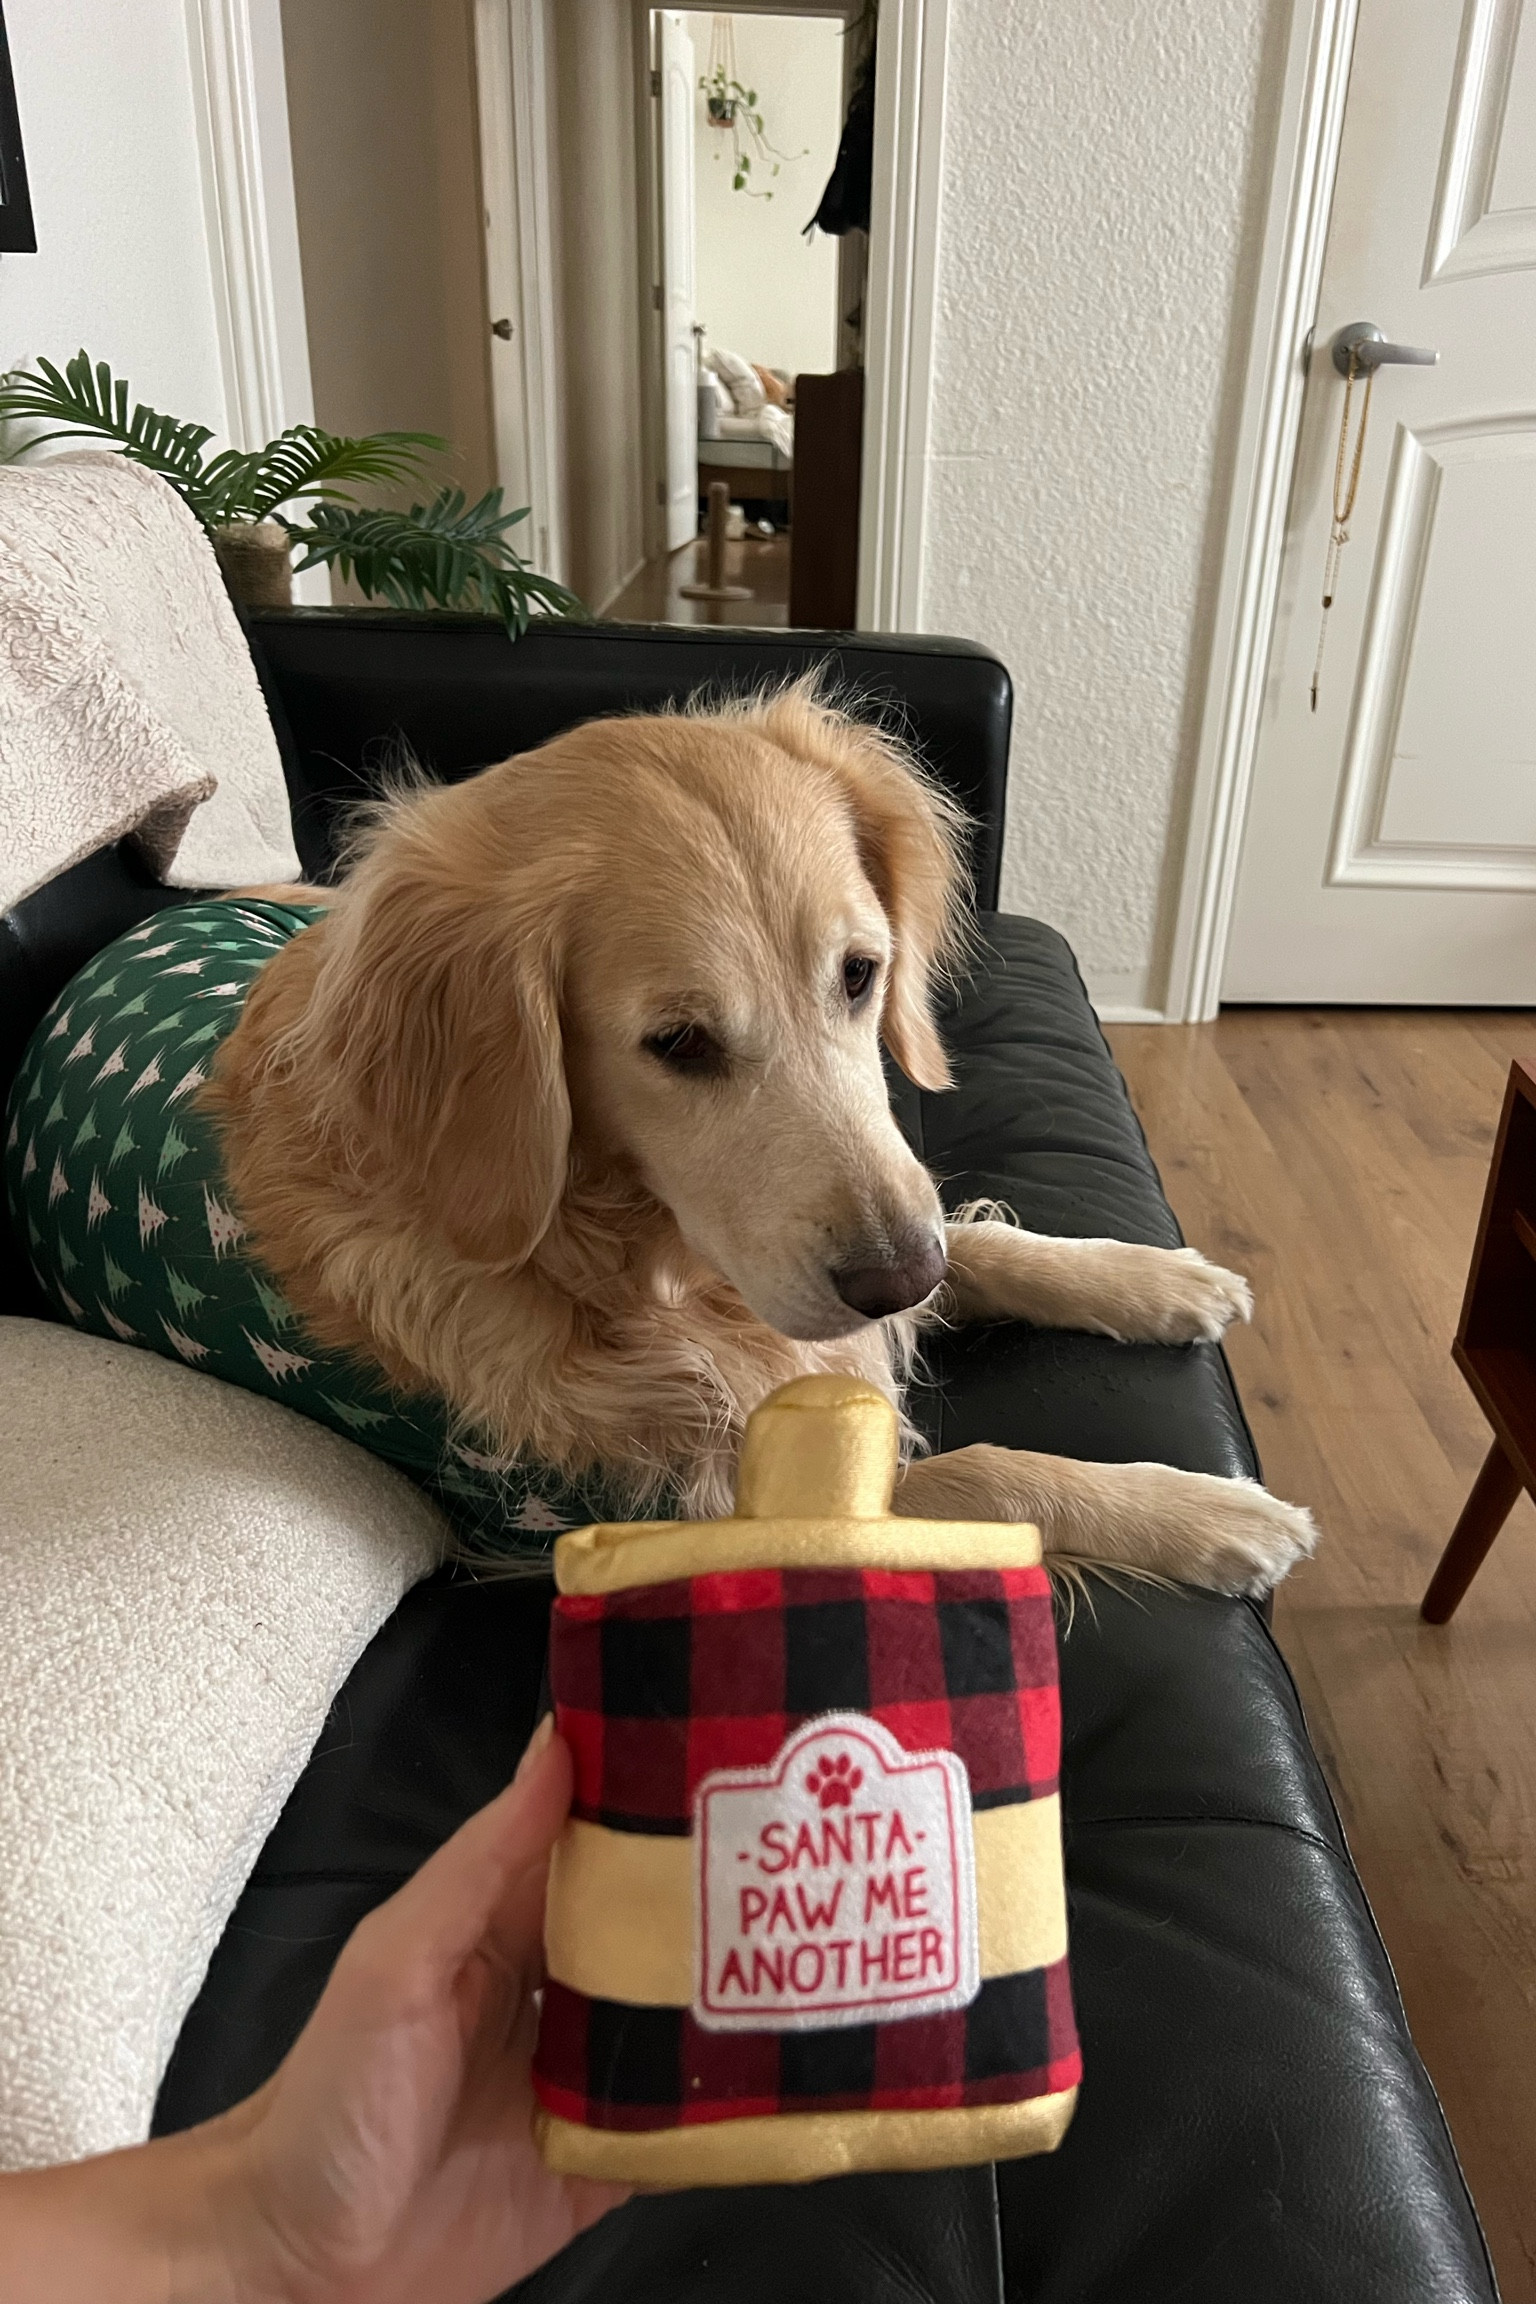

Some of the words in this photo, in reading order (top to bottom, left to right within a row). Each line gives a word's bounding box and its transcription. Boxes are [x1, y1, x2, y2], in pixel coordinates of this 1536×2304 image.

[740, 1880, 844, 1935] PAW
[864, 1867, 928, 1923] ME
[719, 1928, 943, 1995] ANOTHER
